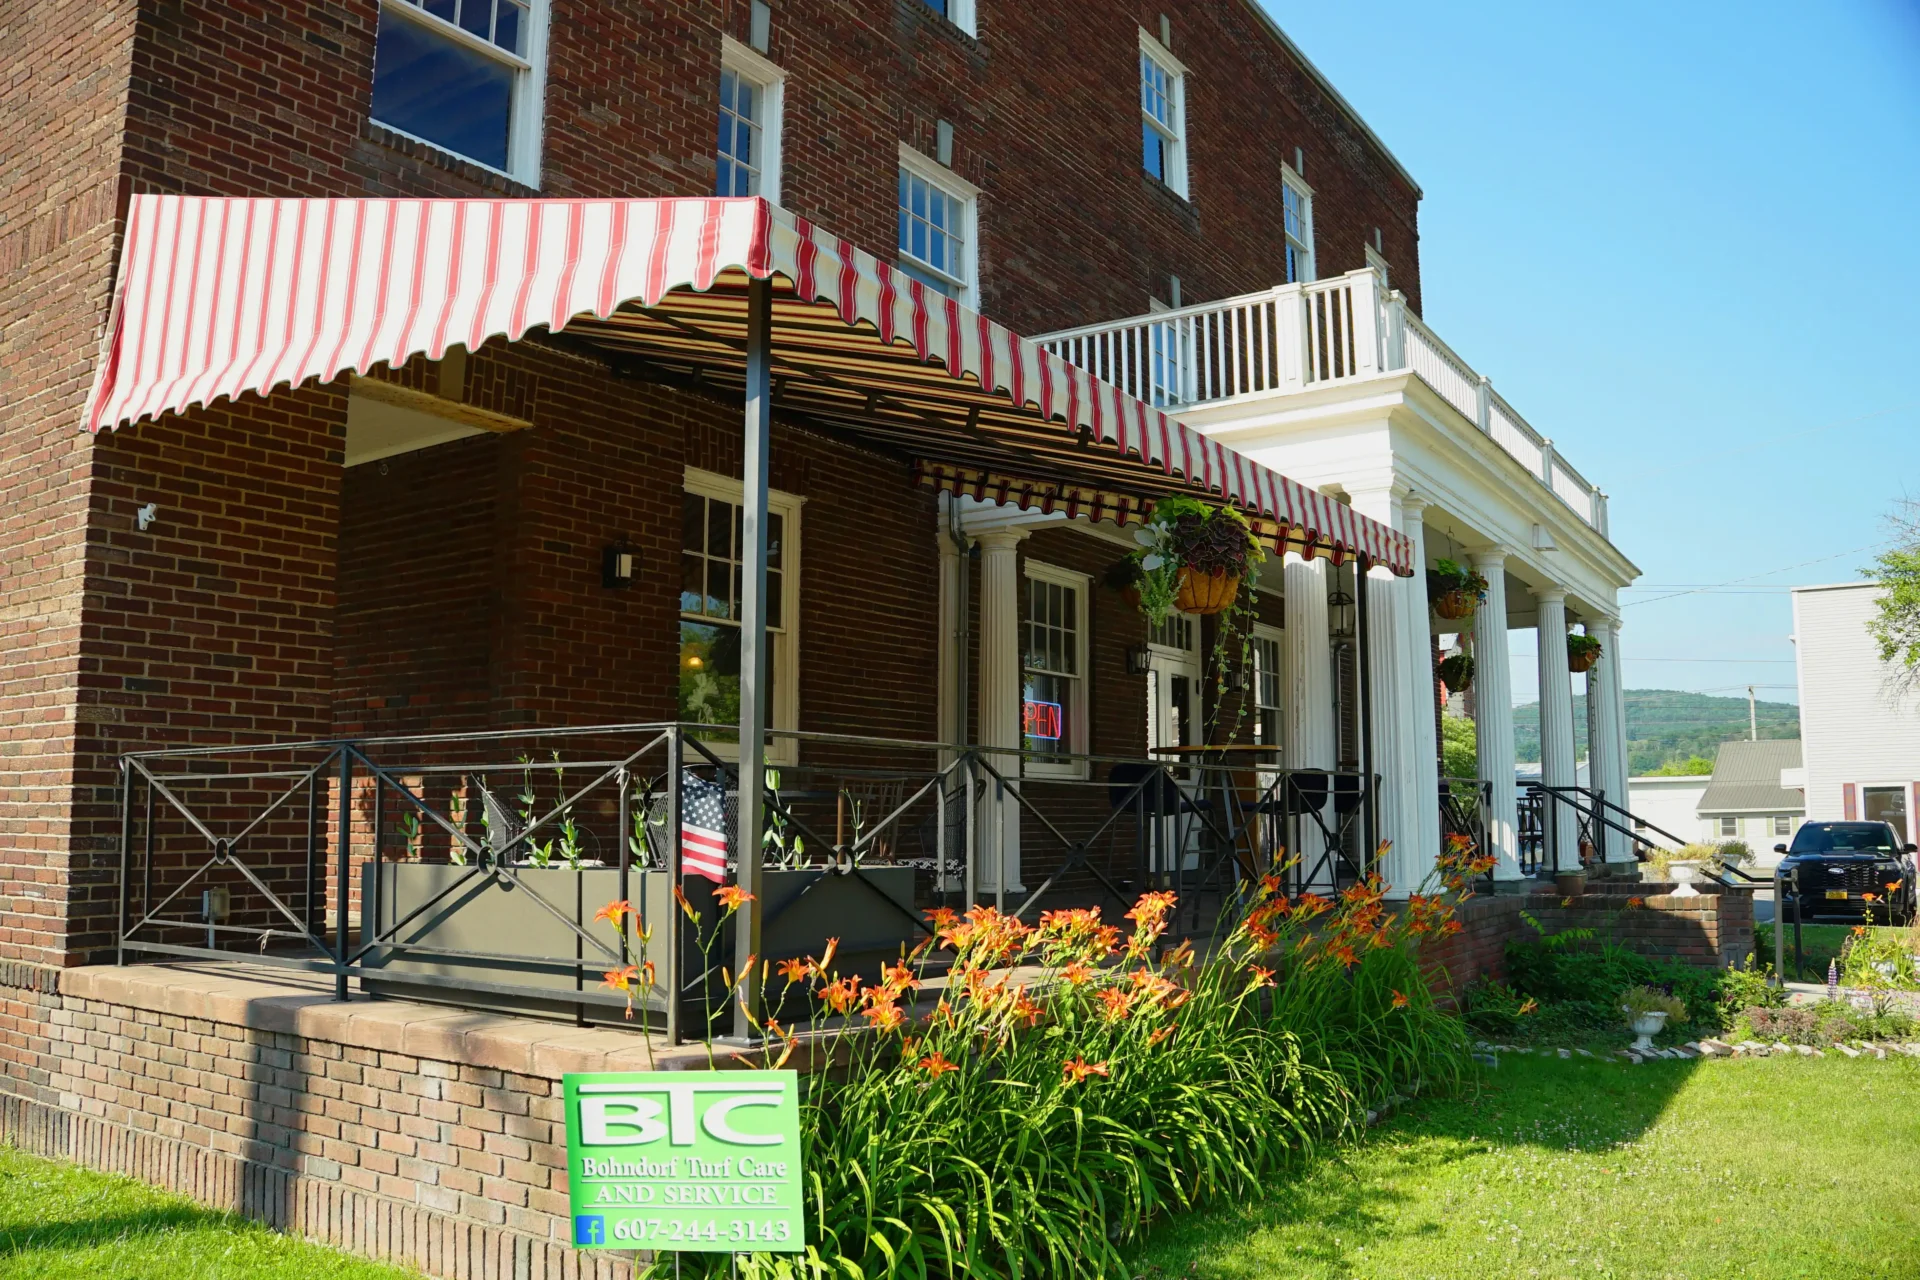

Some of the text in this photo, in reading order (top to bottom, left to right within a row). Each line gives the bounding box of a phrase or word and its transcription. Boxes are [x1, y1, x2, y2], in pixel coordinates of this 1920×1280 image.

[1024, 702, 1060, 738] PEN
[577, 1082, 786, 1146] BTC
[582, 1156, 787, 1177] Bohndorf Turf Care
[594, 1185, 778, 1204] AND SERVICE
[613, 1218, 791, 1242] 607-244-3143
